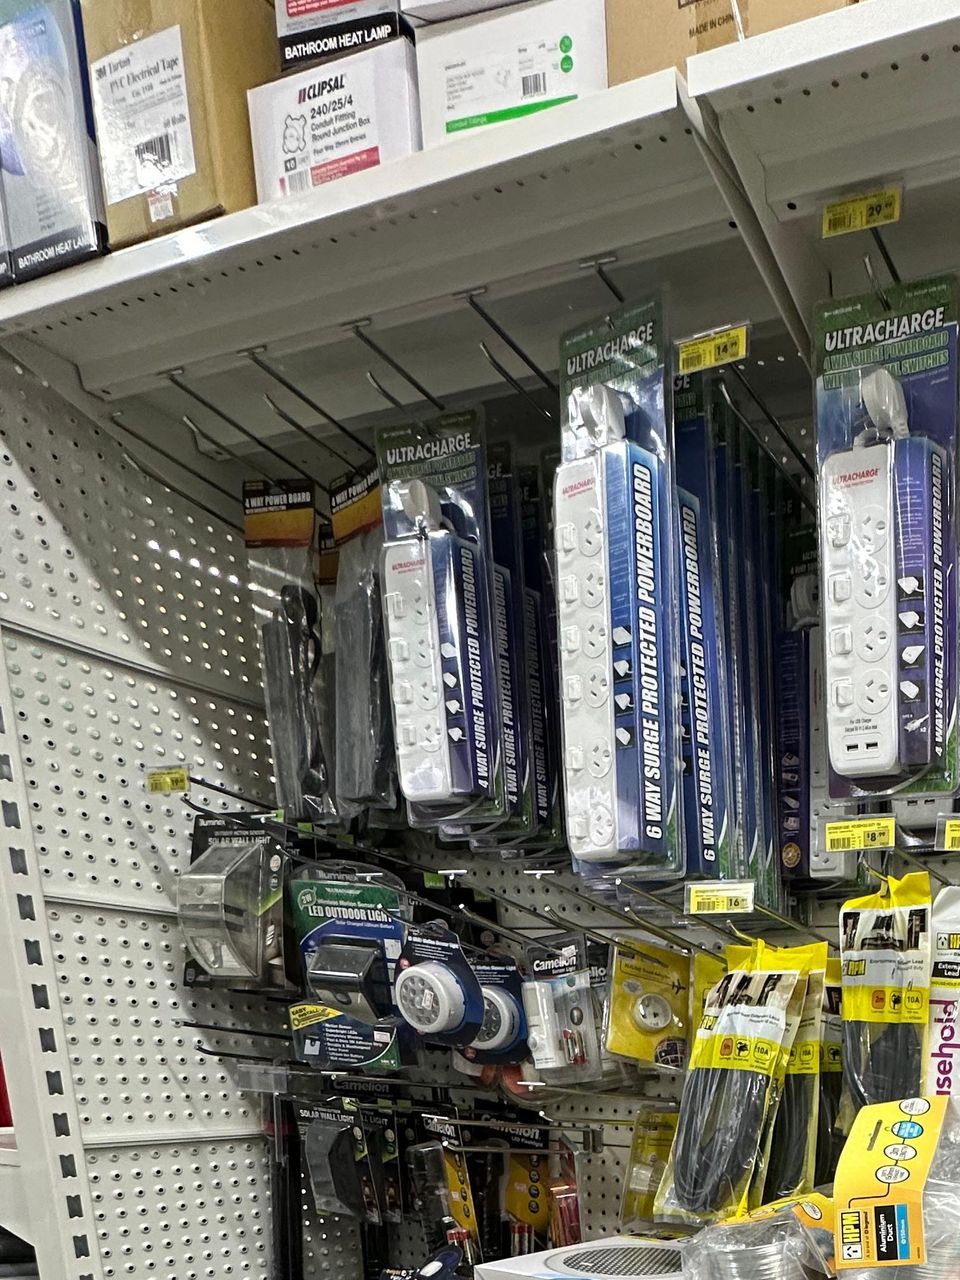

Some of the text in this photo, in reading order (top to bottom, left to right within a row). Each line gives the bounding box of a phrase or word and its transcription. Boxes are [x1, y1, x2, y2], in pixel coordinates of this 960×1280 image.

[285, 25, 391, 59] BATHROOM HEAT LAMP
[689, 20, 717, 39] MADE IN
[127, 62, 159, 85] Electrical
[161, 56, 179, 73] Tape
[307, 75, 345, 100] CLIPSAL
[311, 95, 353, 119] 240/25/4
[311, 118, 334, 132] Conduit
[312, 117, 370, 142] Round Junction Box
[286, 160, 294, 169] 10
[18, 244, 54, 269] BATHROOM
[825, 307, 946, 351] ULTRACHARGE
[567, 322, 654, 376] ULTRACHARGE
[823, 357, 830, 371] 4
[831, 353, 851, 370] WAY
[885, 331, 949, 356] POWERBOARD
[902, 350, 949, 375] SWITCHES
[386, 432, 471, 466] ULTRACHARGE
[245, 492, 310, 508] 4 WAY POWER BOARD
[931, 454, 945, 758] 4 WAY SURGE PROTECTED POWERBOARD
[633, 462, 663, 840] 6 WAY SURGE PROTECTED POWERBOARD
[461, 547, 488, 788] 4 WAY SURGE PROTECTED POWERBOARD
[499, 654, 514, 726] PROTECTED
[682, 506, 716, 862] 6 WAY SURGE PROTECTED POWERBOARD
[504, 726, 516, 772] SURGE
[506, 772, 518, 794] WAY
[508, 792, 517, 804] 4
[309, 906, 366, 920] LED OUTDOOR
[757, 1046, 769, 1055] 10A
[300, 1109, 355, 1123] SOLAR WALL LIGHT
[842, 1212, 861, 1243] HPM
[886, 1224, 894, 1242] Duct
